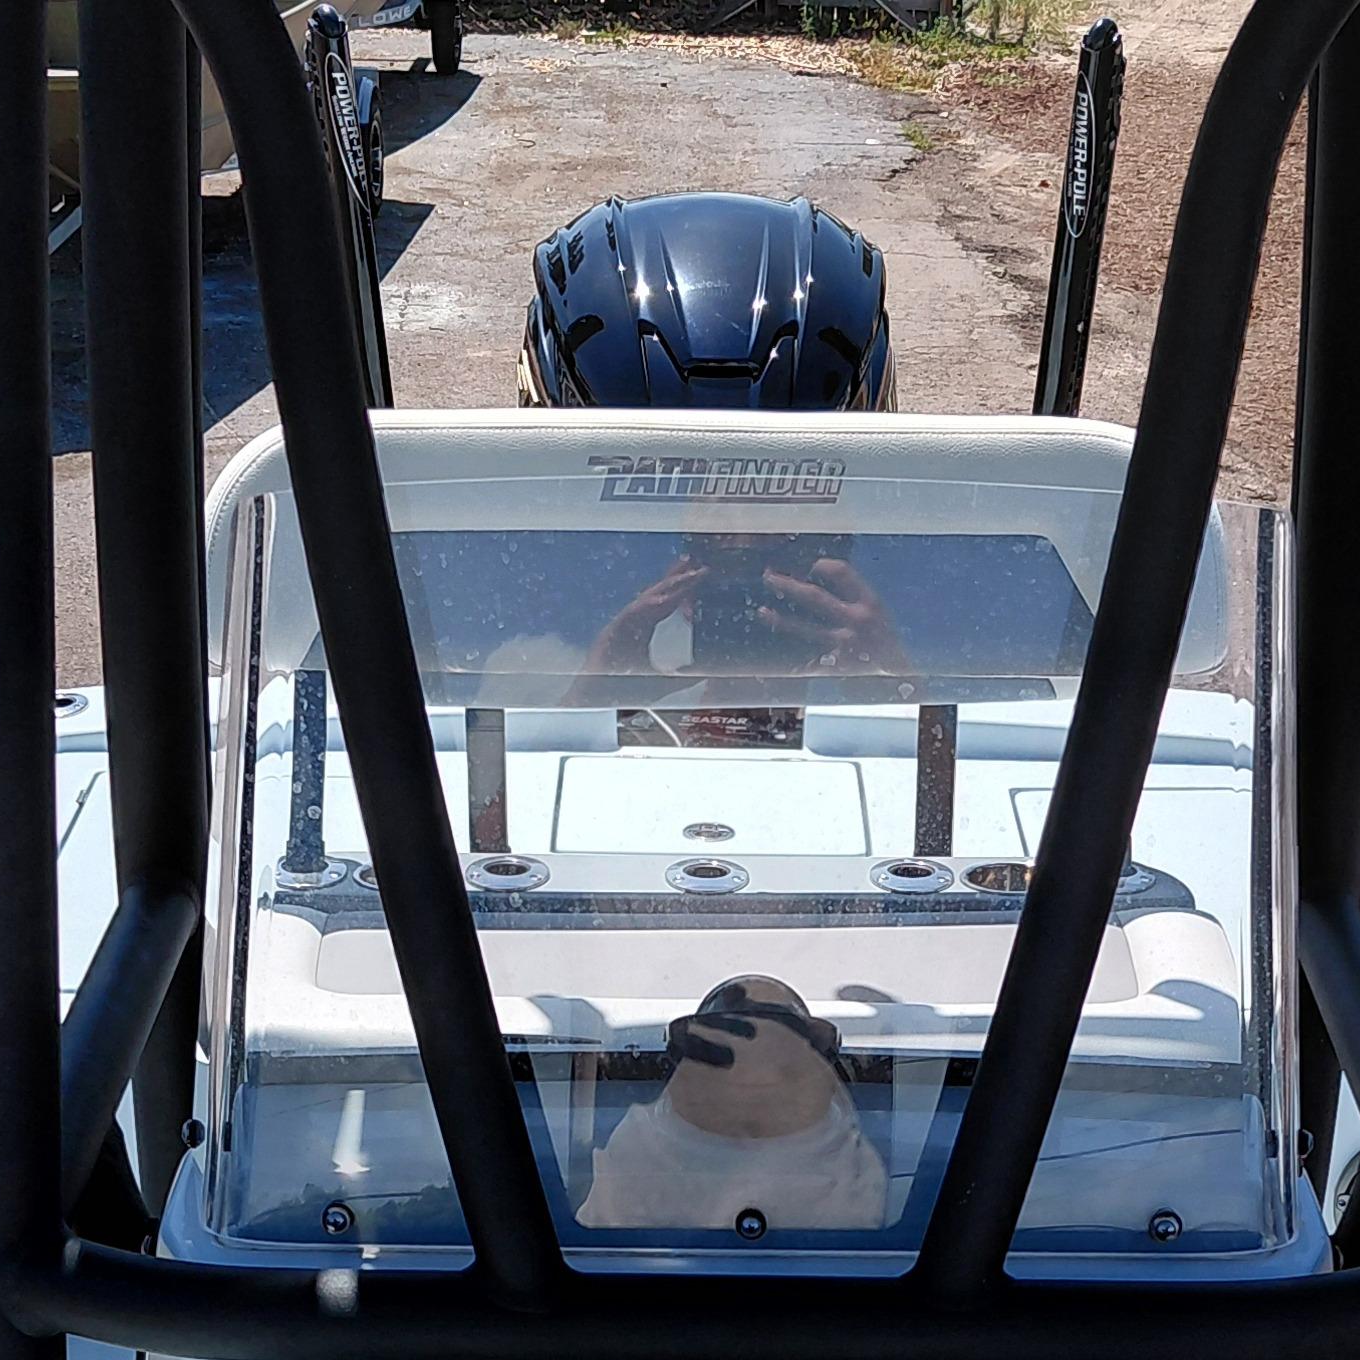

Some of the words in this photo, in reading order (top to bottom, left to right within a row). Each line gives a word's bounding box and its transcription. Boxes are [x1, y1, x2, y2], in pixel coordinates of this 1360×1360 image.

[358, 5, 411, 27] LOWE
[1074, 91, 1089, 216] POWER-POLE
[587, 456, 845, 503] PATHFINDER
